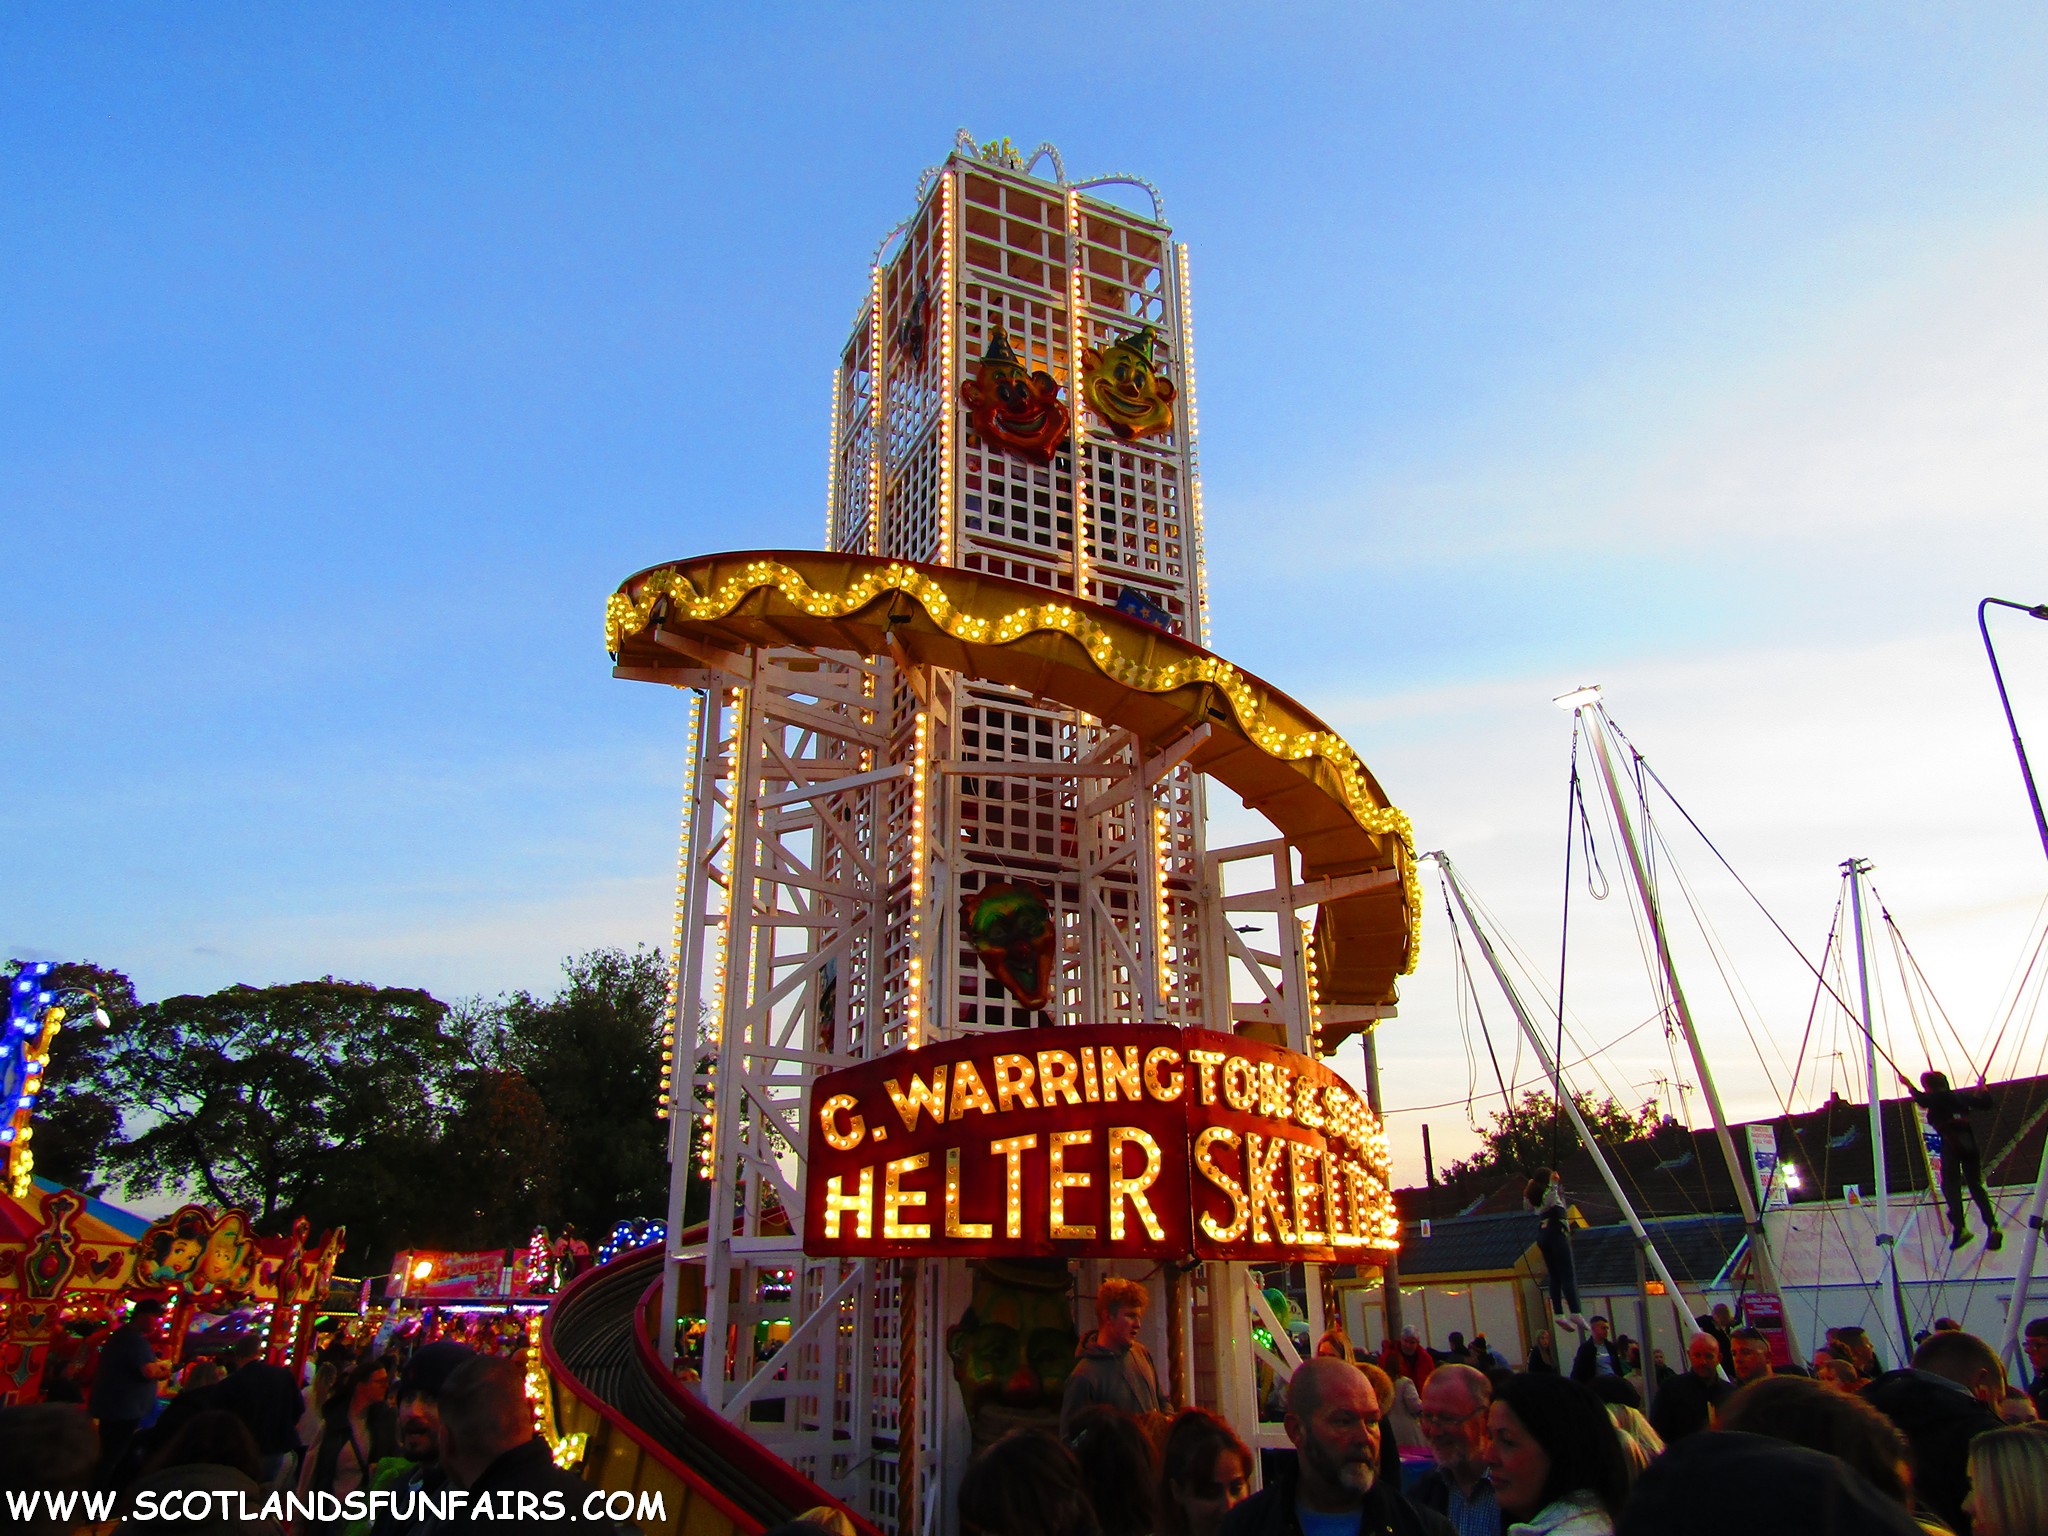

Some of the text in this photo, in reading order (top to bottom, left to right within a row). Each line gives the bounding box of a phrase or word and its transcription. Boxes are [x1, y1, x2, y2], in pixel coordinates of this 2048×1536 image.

[820, 1093, 888, 1151] G.
[883, 1045, 1293, 1133] WARRINGTON
[1294, 1075, 1325, 1129] &
[824, 1126, 1167, 1241] HELTER
